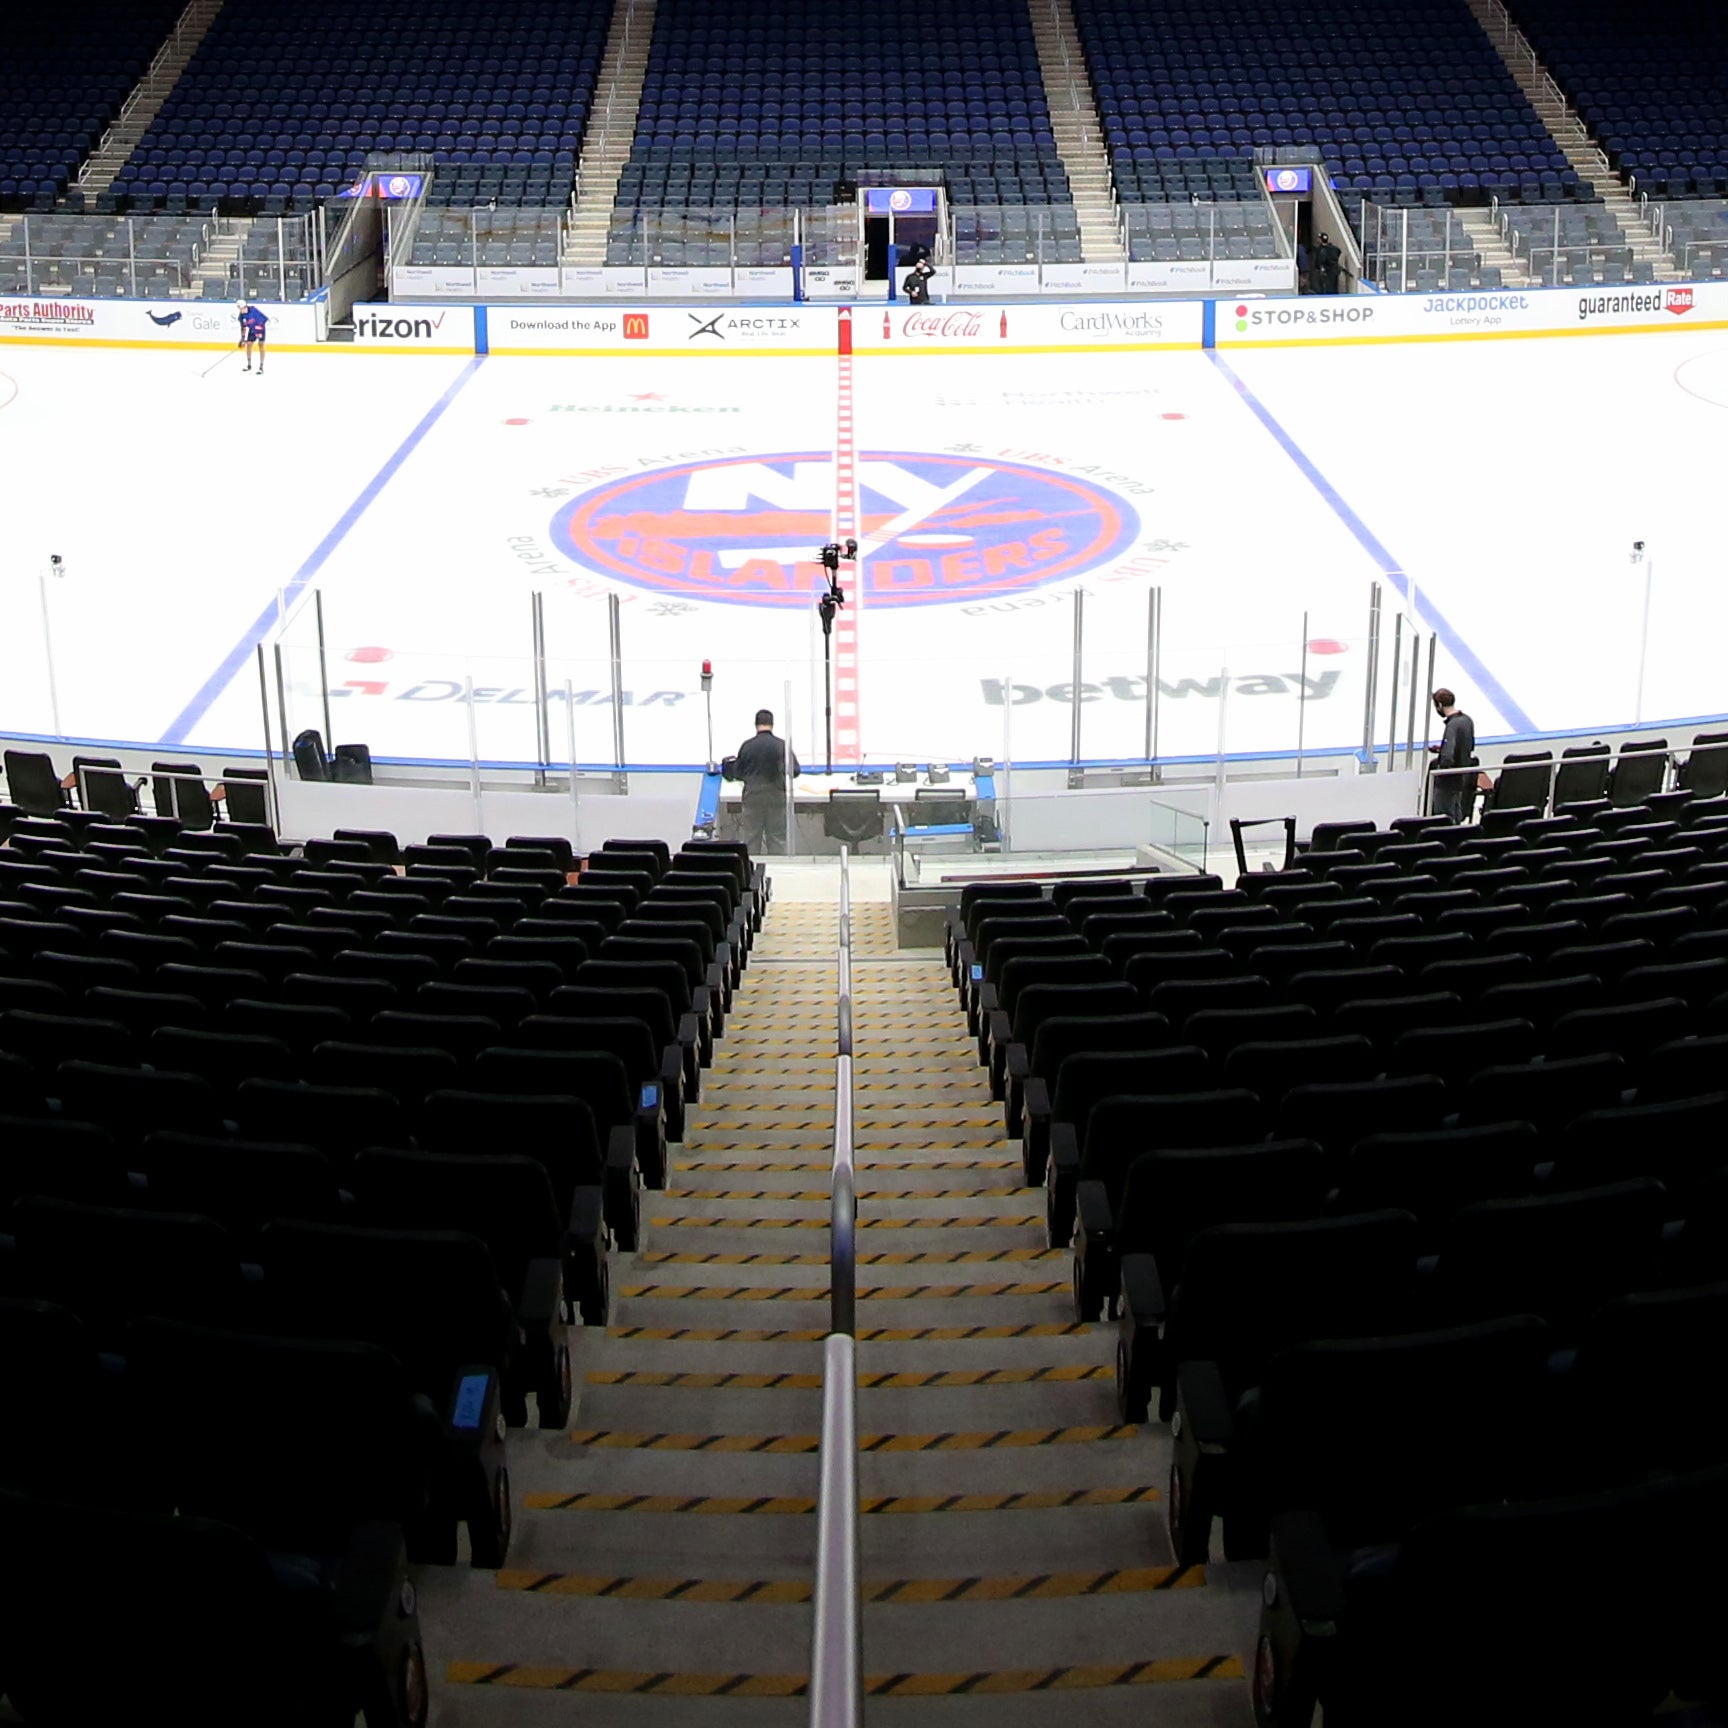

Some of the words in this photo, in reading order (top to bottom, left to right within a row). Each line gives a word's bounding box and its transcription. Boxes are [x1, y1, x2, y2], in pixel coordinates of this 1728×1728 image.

[33, 301, 94, 321] Authority
[1578, 289, 1662, 319] guaranteed
[1666, 291, 1693, 308] Rate
[191, 316, 221, 331] Gale
[510, 319, 570, 330] Download
[572, 319, 590, 330] the
[593, 320, 617, 333] App
[727, 319, 801, 329] ARCTIX
[1059, 311, 1163, 333] CardWorks
[1251, 307, 1374, 325] STOP&SHOP
[1450, 316, 1479, 326] Lottery
[1482, 315, 1501, 326] App
[548, 402, 742, 414] Heineken
[559, 464, 627, 485] UBS
[636, 446, 746, 466] Arena
[998, 447, 1073, 465] UBS
[1078, 462, 1156, 497] Arena
[615, 528, 1070, 590] ISLANDERS
[979, 669, 1342, 707] betway
